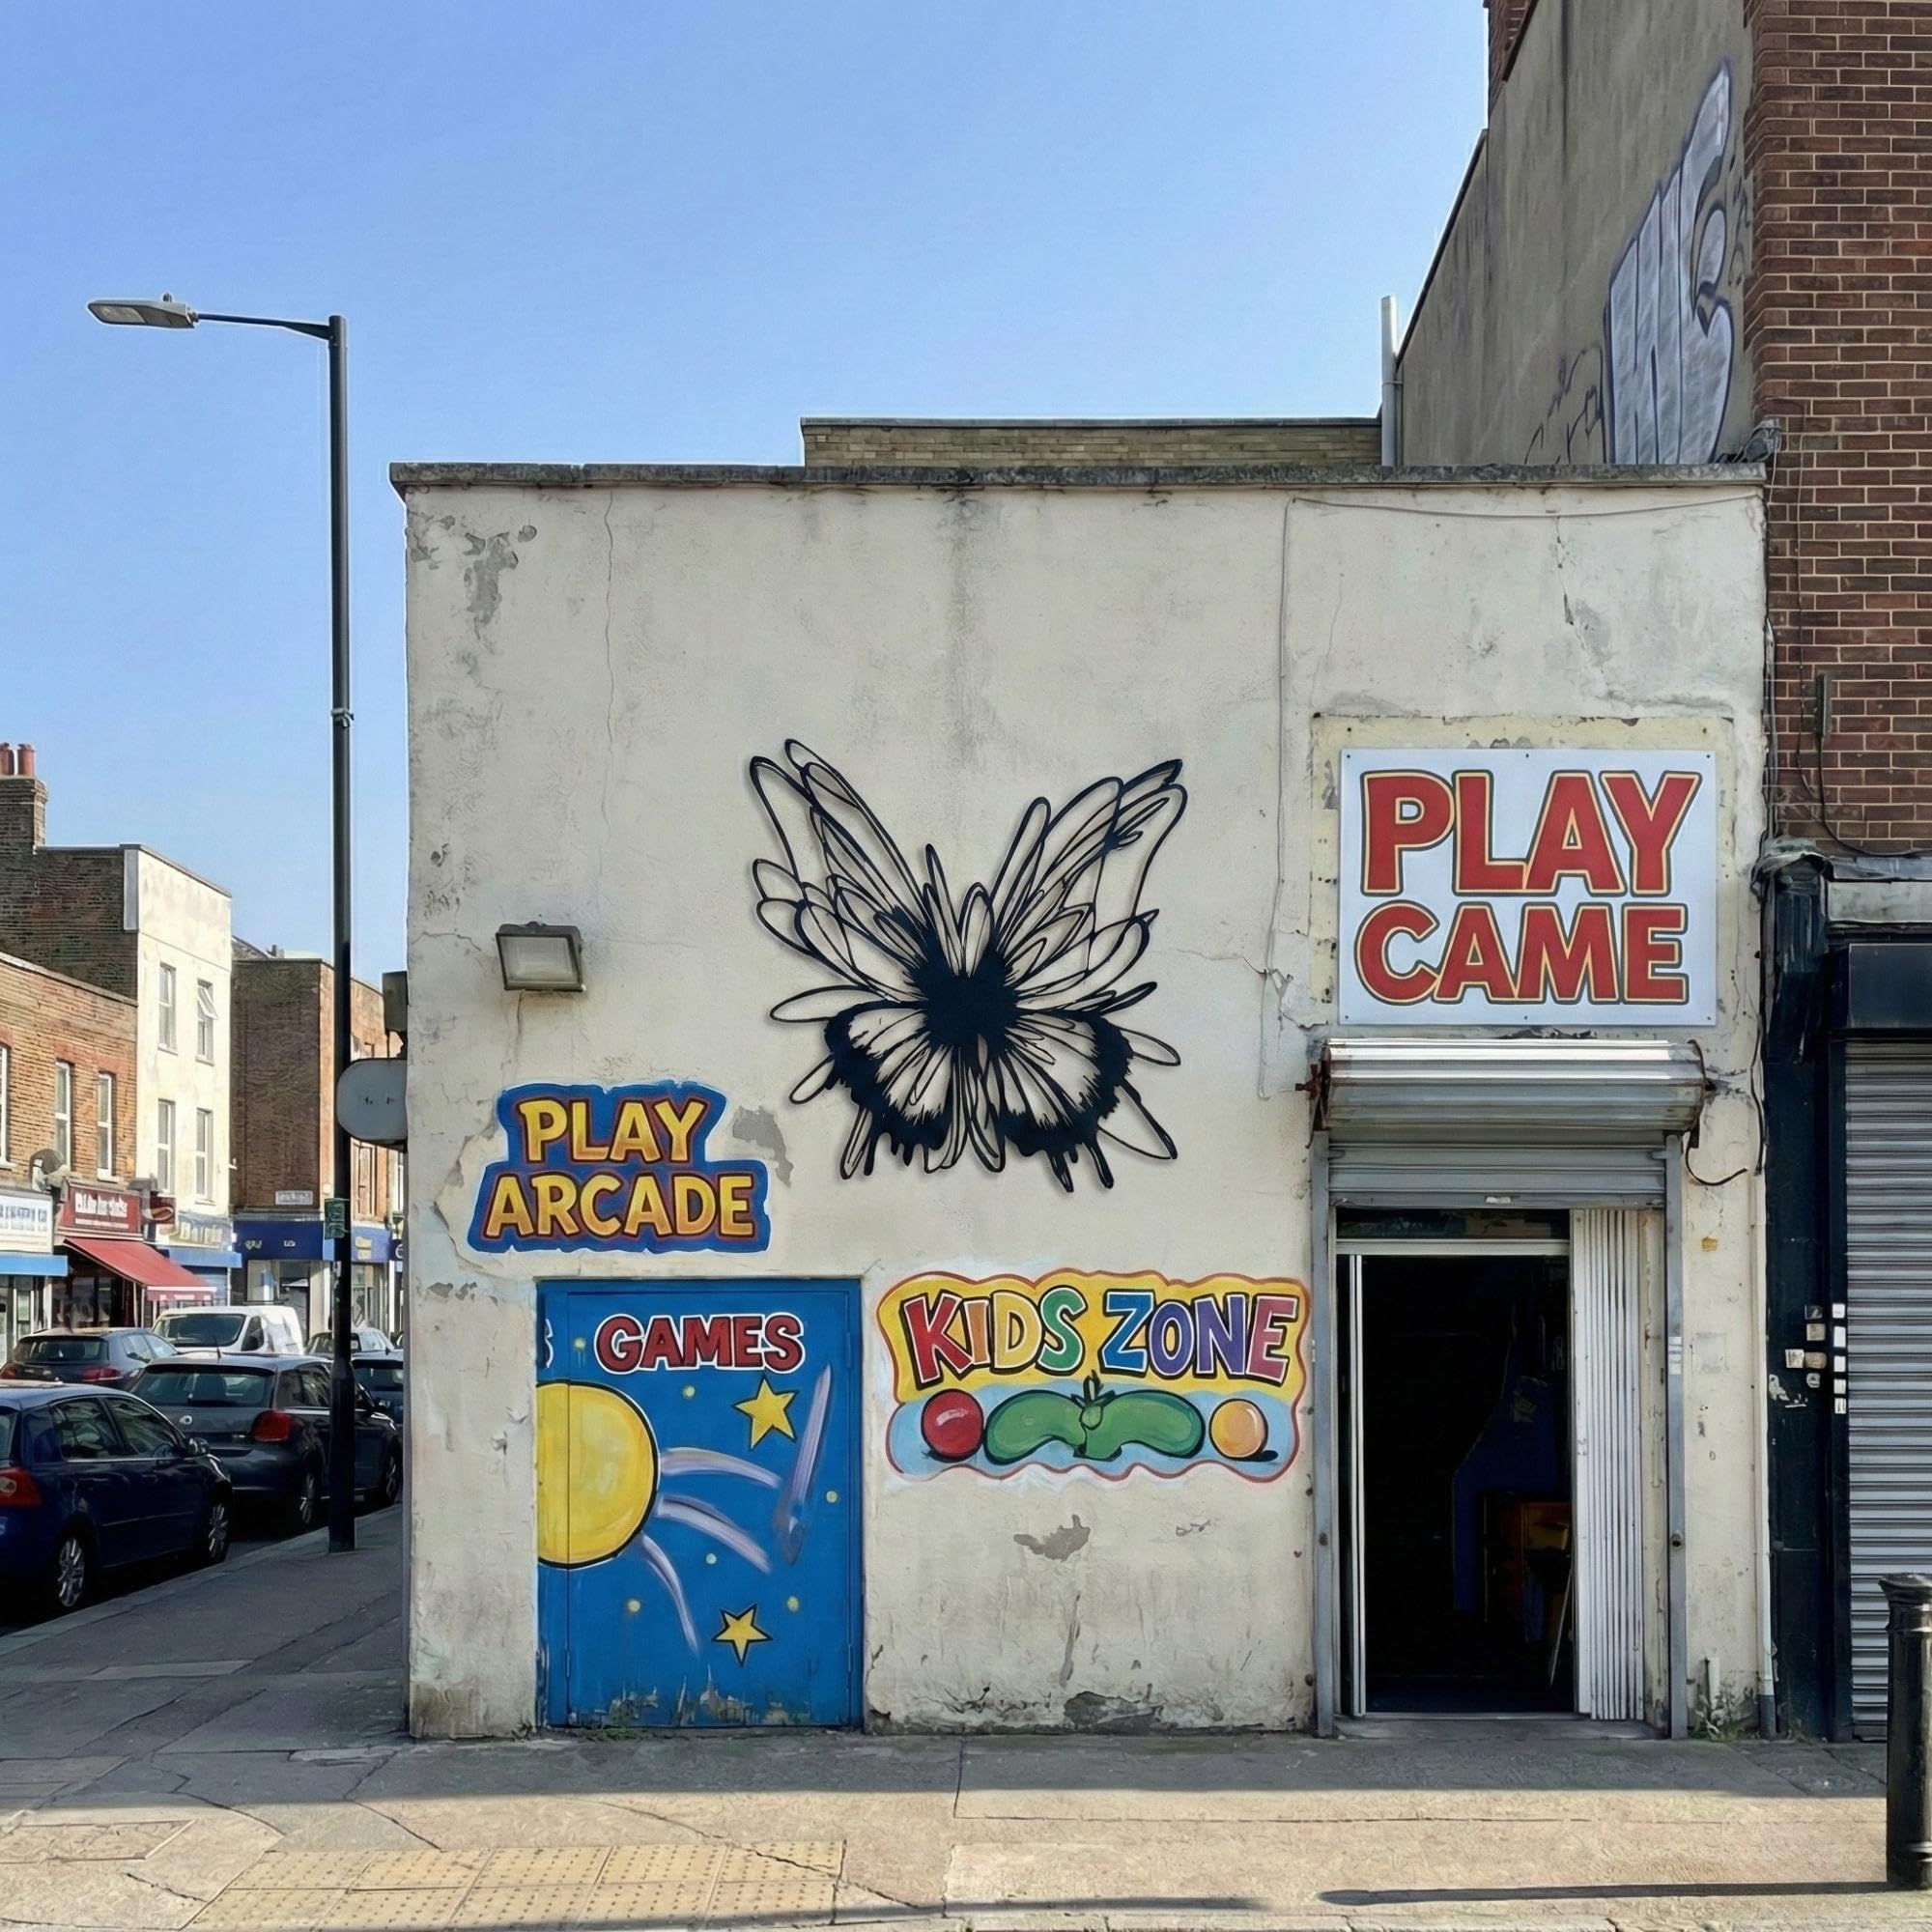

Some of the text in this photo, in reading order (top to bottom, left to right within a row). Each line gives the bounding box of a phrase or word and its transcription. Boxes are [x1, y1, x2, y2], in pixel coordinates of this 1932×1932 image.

[1362, 770, 1702, 896] PLAY
[1354, 900, 1689, 1006] CAME
[519, 1097, 708, 1163] PLAY
[483, 1172, 756, 1239] ARCADE
[594, 1312, 805, 1373] GAMES
[899, 1286, 1300, 1390] KIDS ZONE
